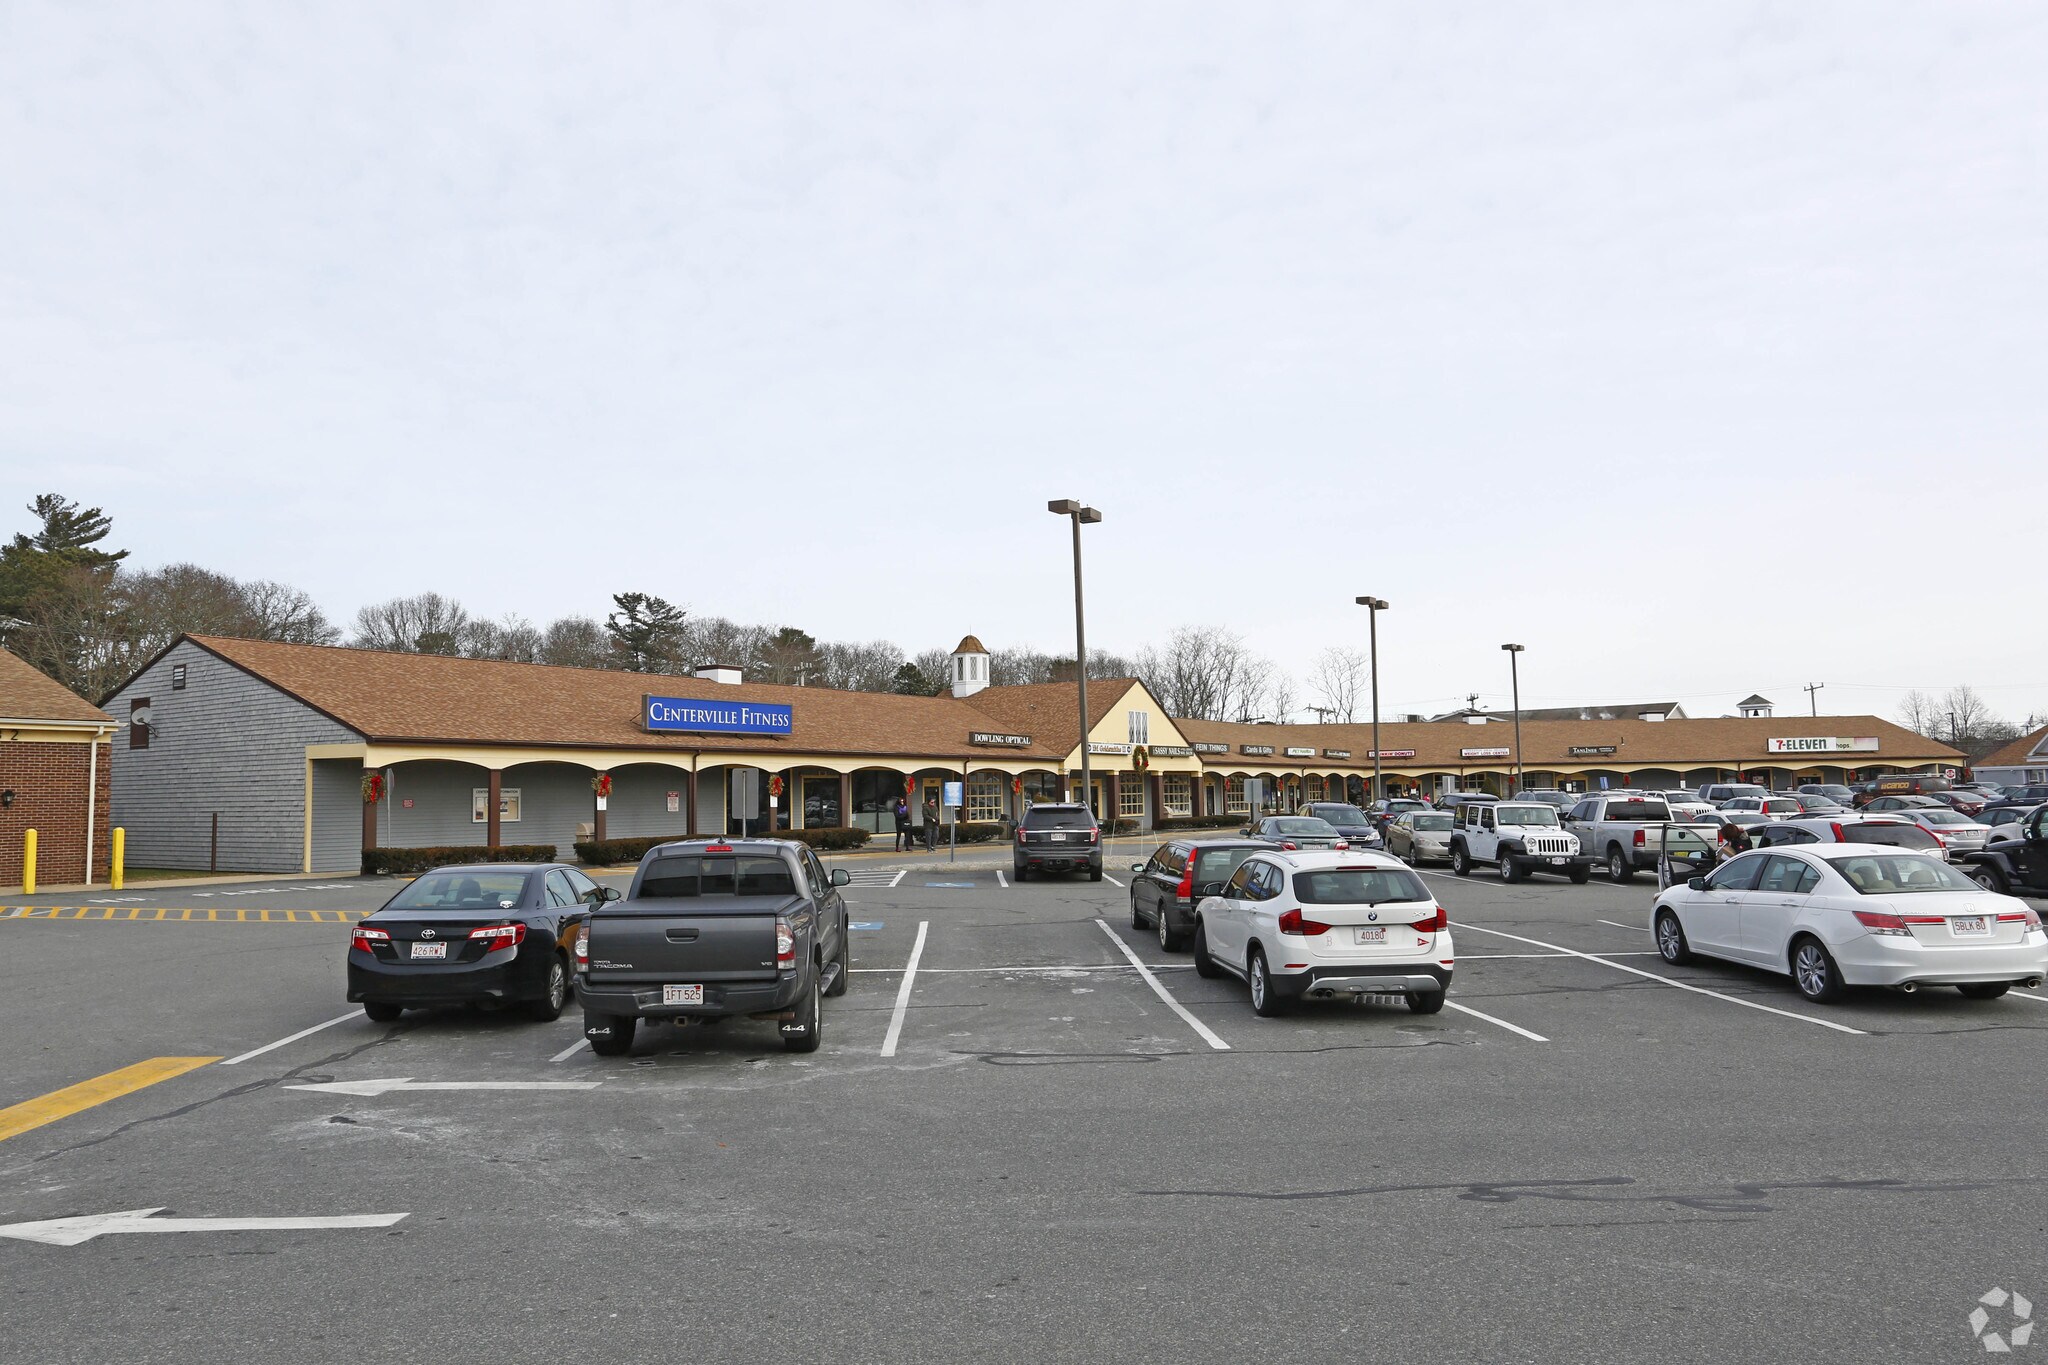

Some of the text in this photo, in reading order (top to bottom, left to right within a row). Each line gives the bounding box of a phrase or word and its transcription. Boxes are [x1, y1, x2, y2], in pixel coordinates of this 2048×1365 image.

[650, 703, 789, 726] CENTERVILLE FITNESS
[975, 734, 1031, 744] DOWLING OPTICAL
[1195, 743, 1228, 752] FEIN THINGS
[413, 946, 428, 955] 426
